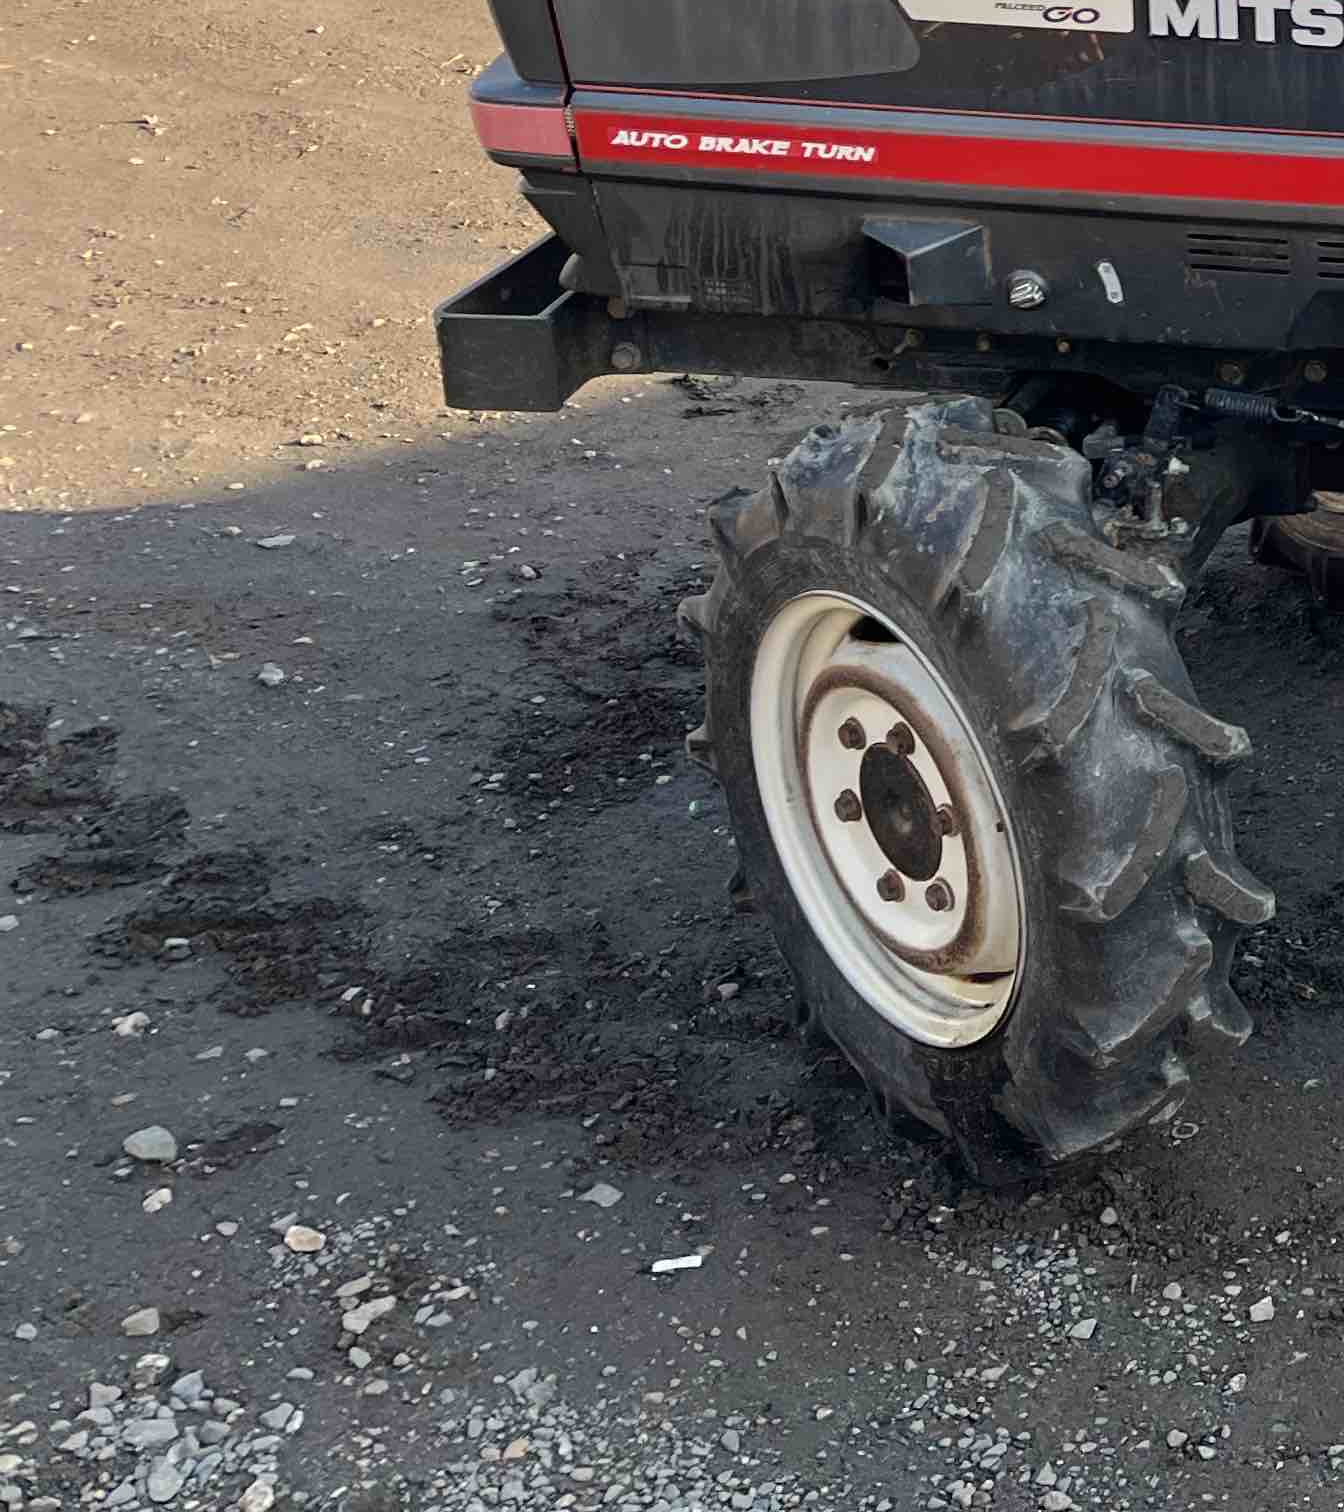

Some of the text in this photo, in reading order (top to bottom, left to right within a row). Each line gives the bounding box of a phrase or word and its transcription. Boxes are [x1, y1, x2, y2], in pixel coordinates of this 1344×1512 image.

[1042, 6, 1100, 24] GO
[610, 130, 876, 162] AUTO BRAKE TURN
